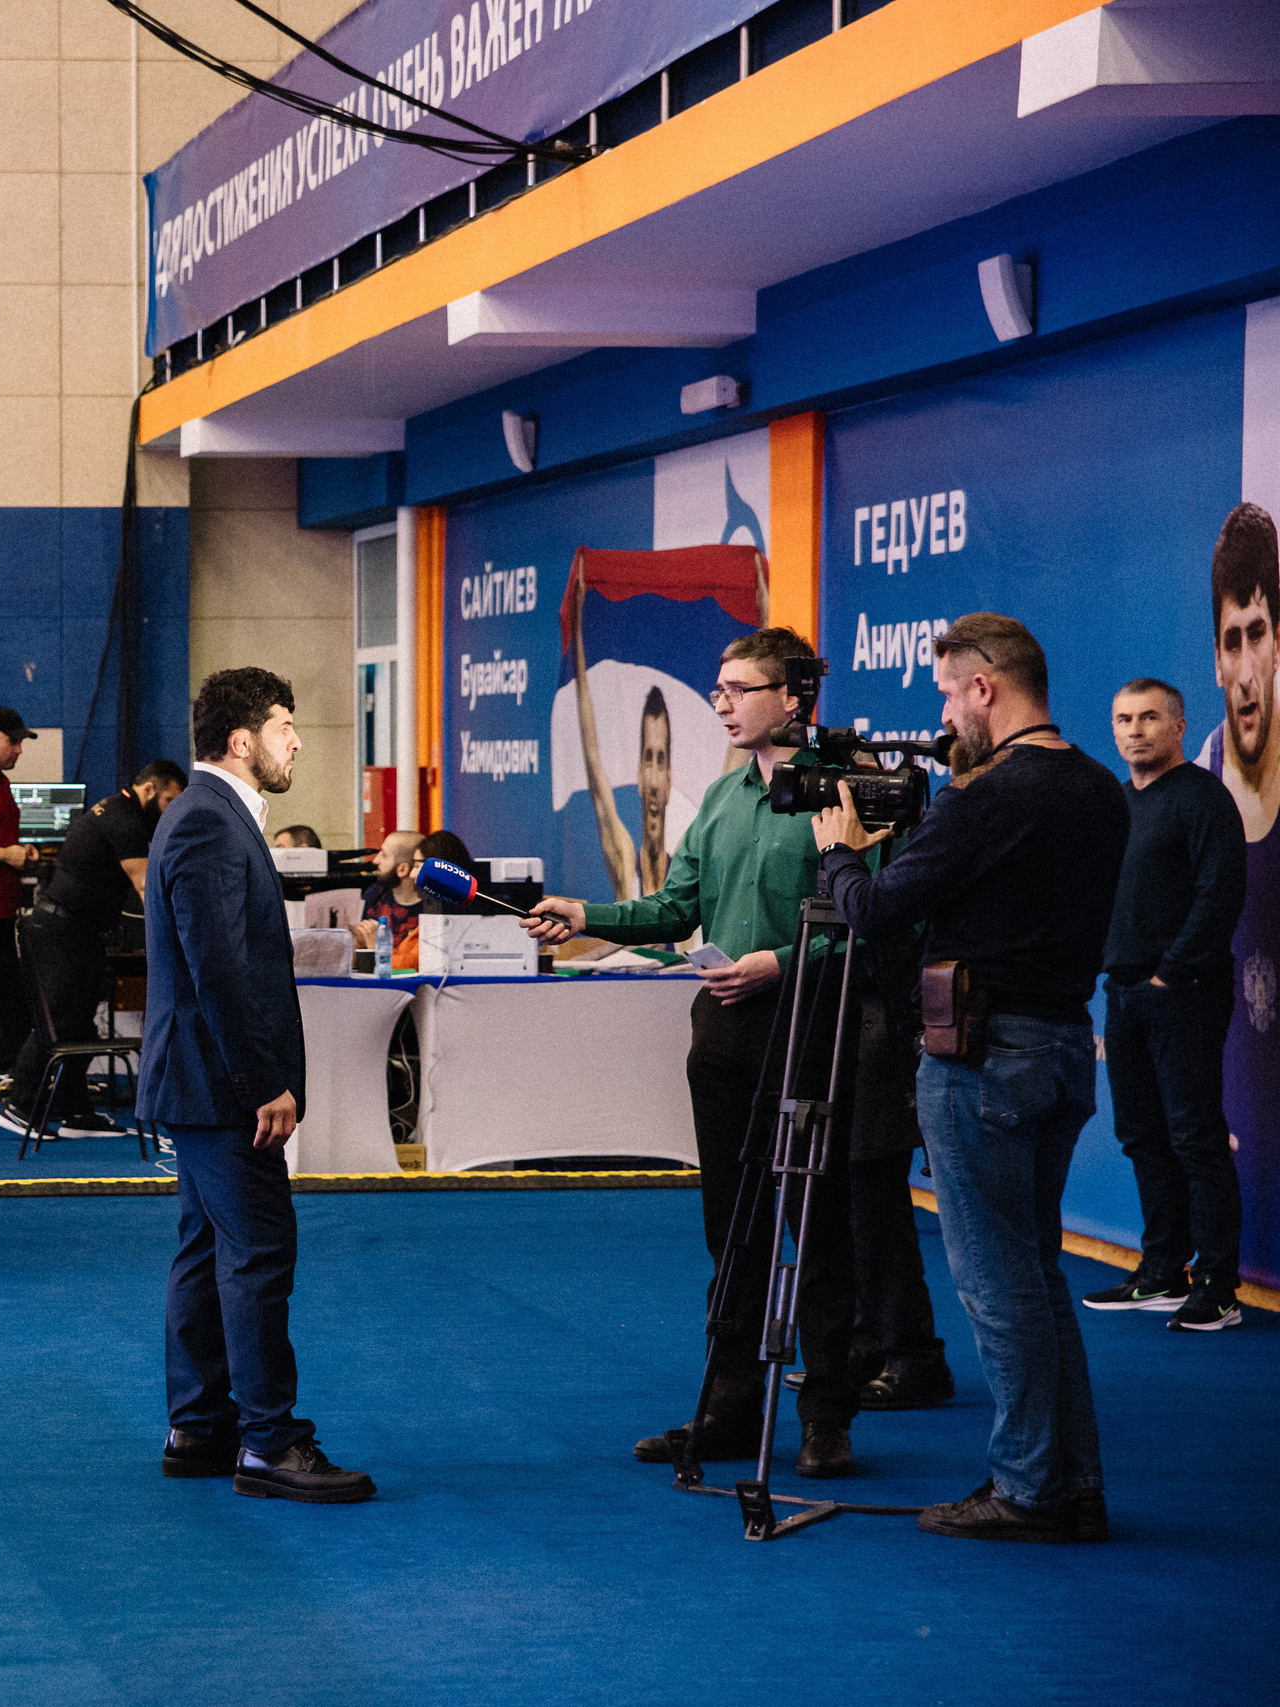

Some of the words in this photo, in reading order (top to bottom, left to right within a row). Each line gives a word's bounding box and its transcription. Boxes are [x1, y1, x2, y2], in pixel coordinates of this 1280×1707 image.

[180, 137, 293, 285] ДОСТИЖЕНИЯ
[296, 85, 368, 200] УСПЕХА
[373, 32, 444, 148] ОЧЕНЬ
[854, 490, 966, 575] ГЕДУЕВ
[461, 561, 537, 620] САЙТИЕВ
[461, 649, 528, 711] Бувайсар
[460, 730, 538, 782] Хамидович
[434, 860, 470, 881] РОССИЯ
